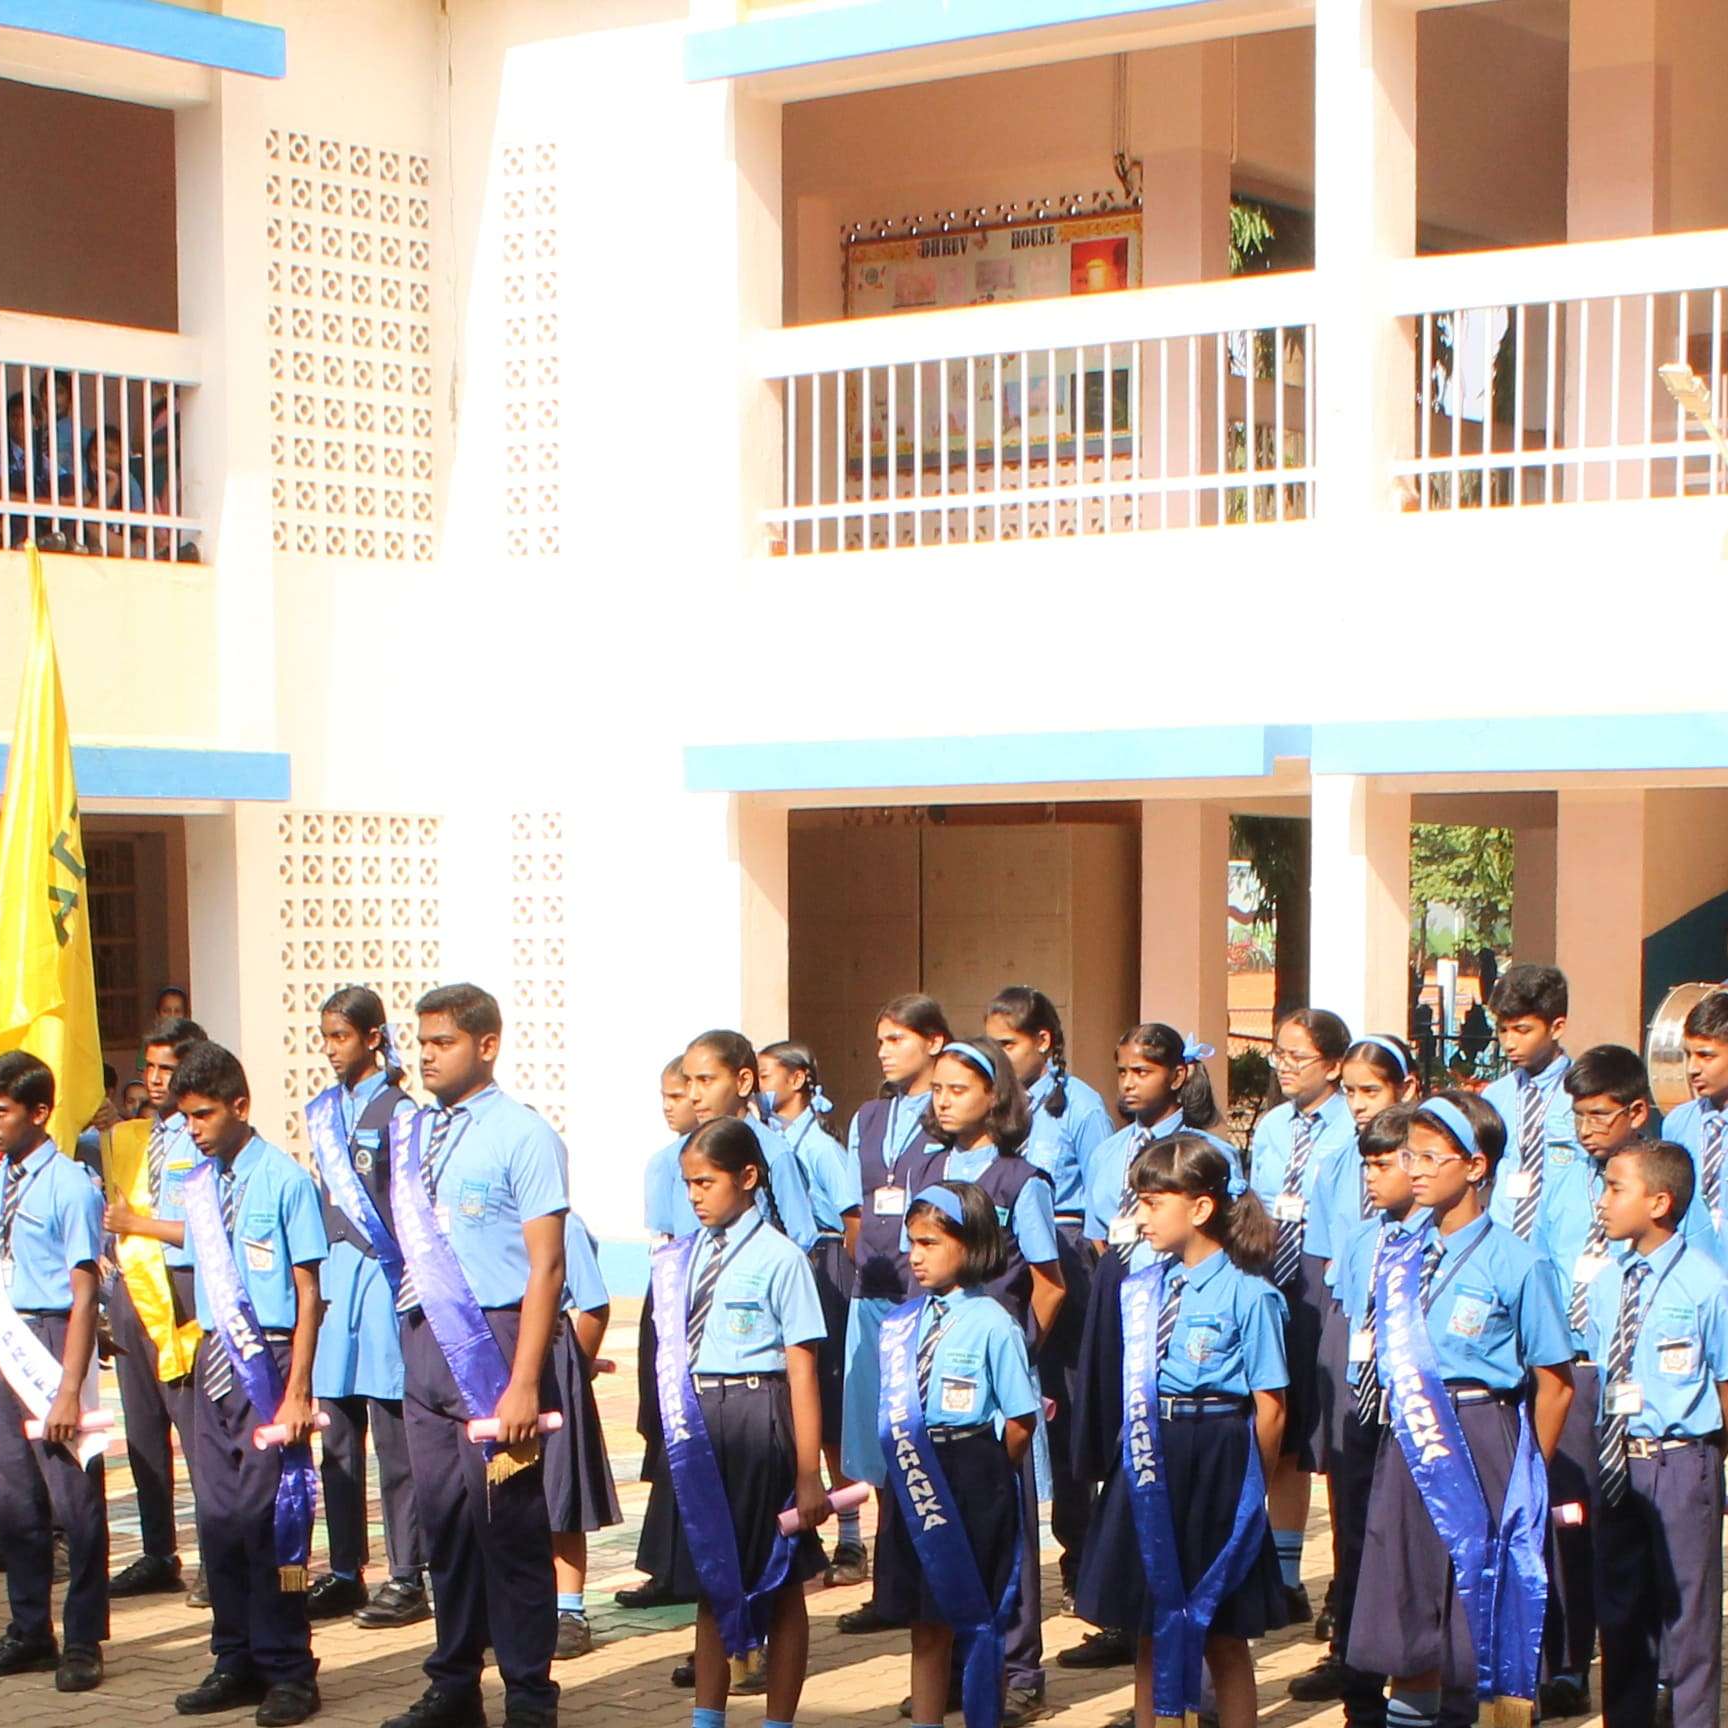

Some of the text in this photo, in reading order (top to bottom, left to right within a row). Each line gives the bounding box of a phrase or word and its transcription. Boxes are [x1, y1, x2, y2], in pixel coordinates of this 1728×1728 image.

[921, 227, 1056, 258] DHRUV HOUSE
[1129, 1340, 1156, 1487] YELAHANKA
[1385, 1312, 1451, 1464] YELAHANKA
[888, 1390, 948, 1531] YELAHANKA
